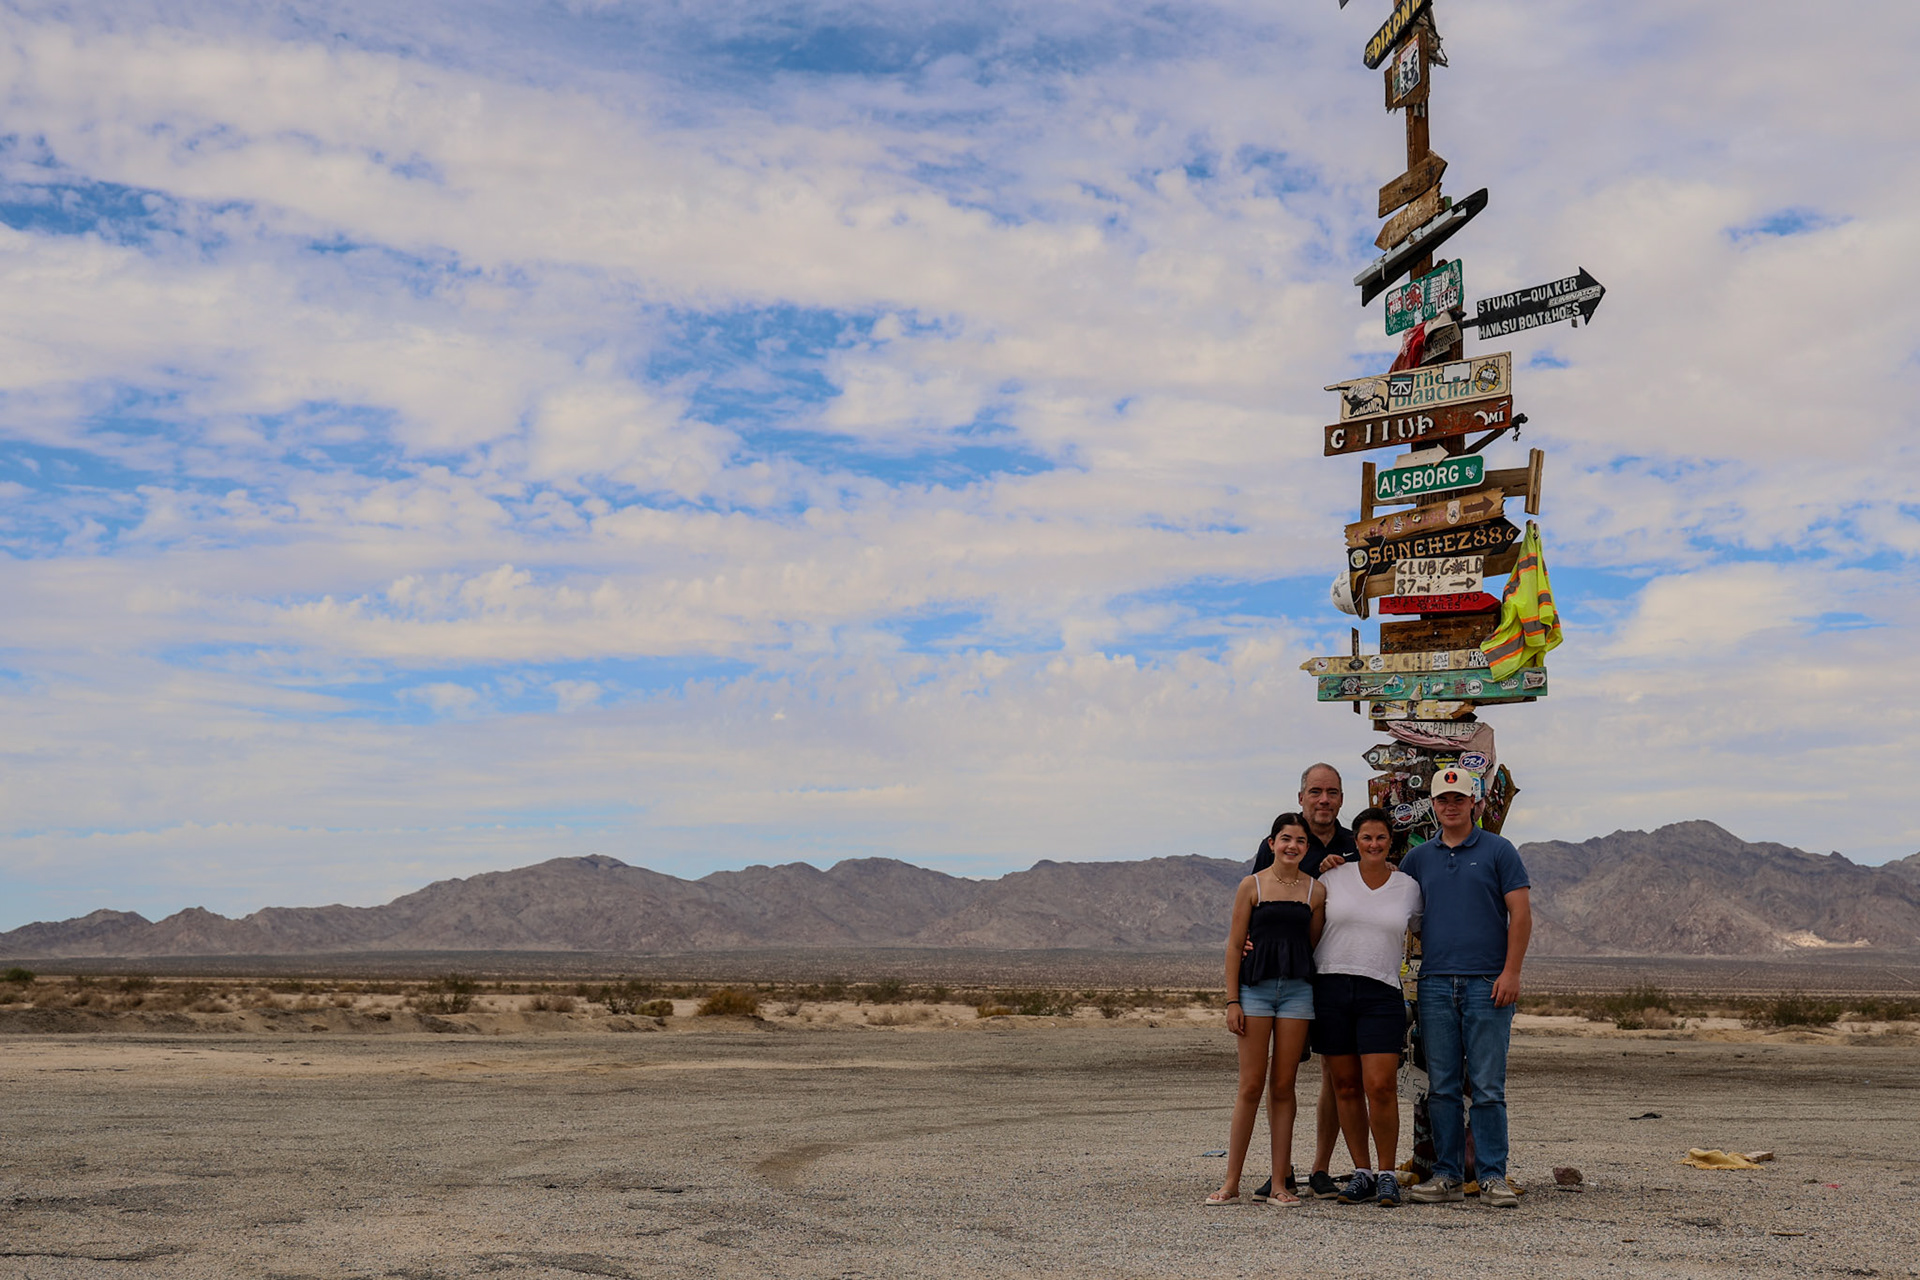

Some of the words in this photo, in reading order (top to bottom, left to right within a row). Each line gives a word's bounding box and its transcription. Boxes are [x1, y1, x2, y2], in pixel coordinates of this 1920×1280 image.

[1373, 0, 1410, 59] DIXON
[1478, 320, 1517, 340] HAVASU
[1415, 370, 1443, 388] The
[1368, 529, 1473, 564] SANCHEZ
[1396, 559, 1438, 576] CLUB
[1458, 592, 1481, 603] PAD
